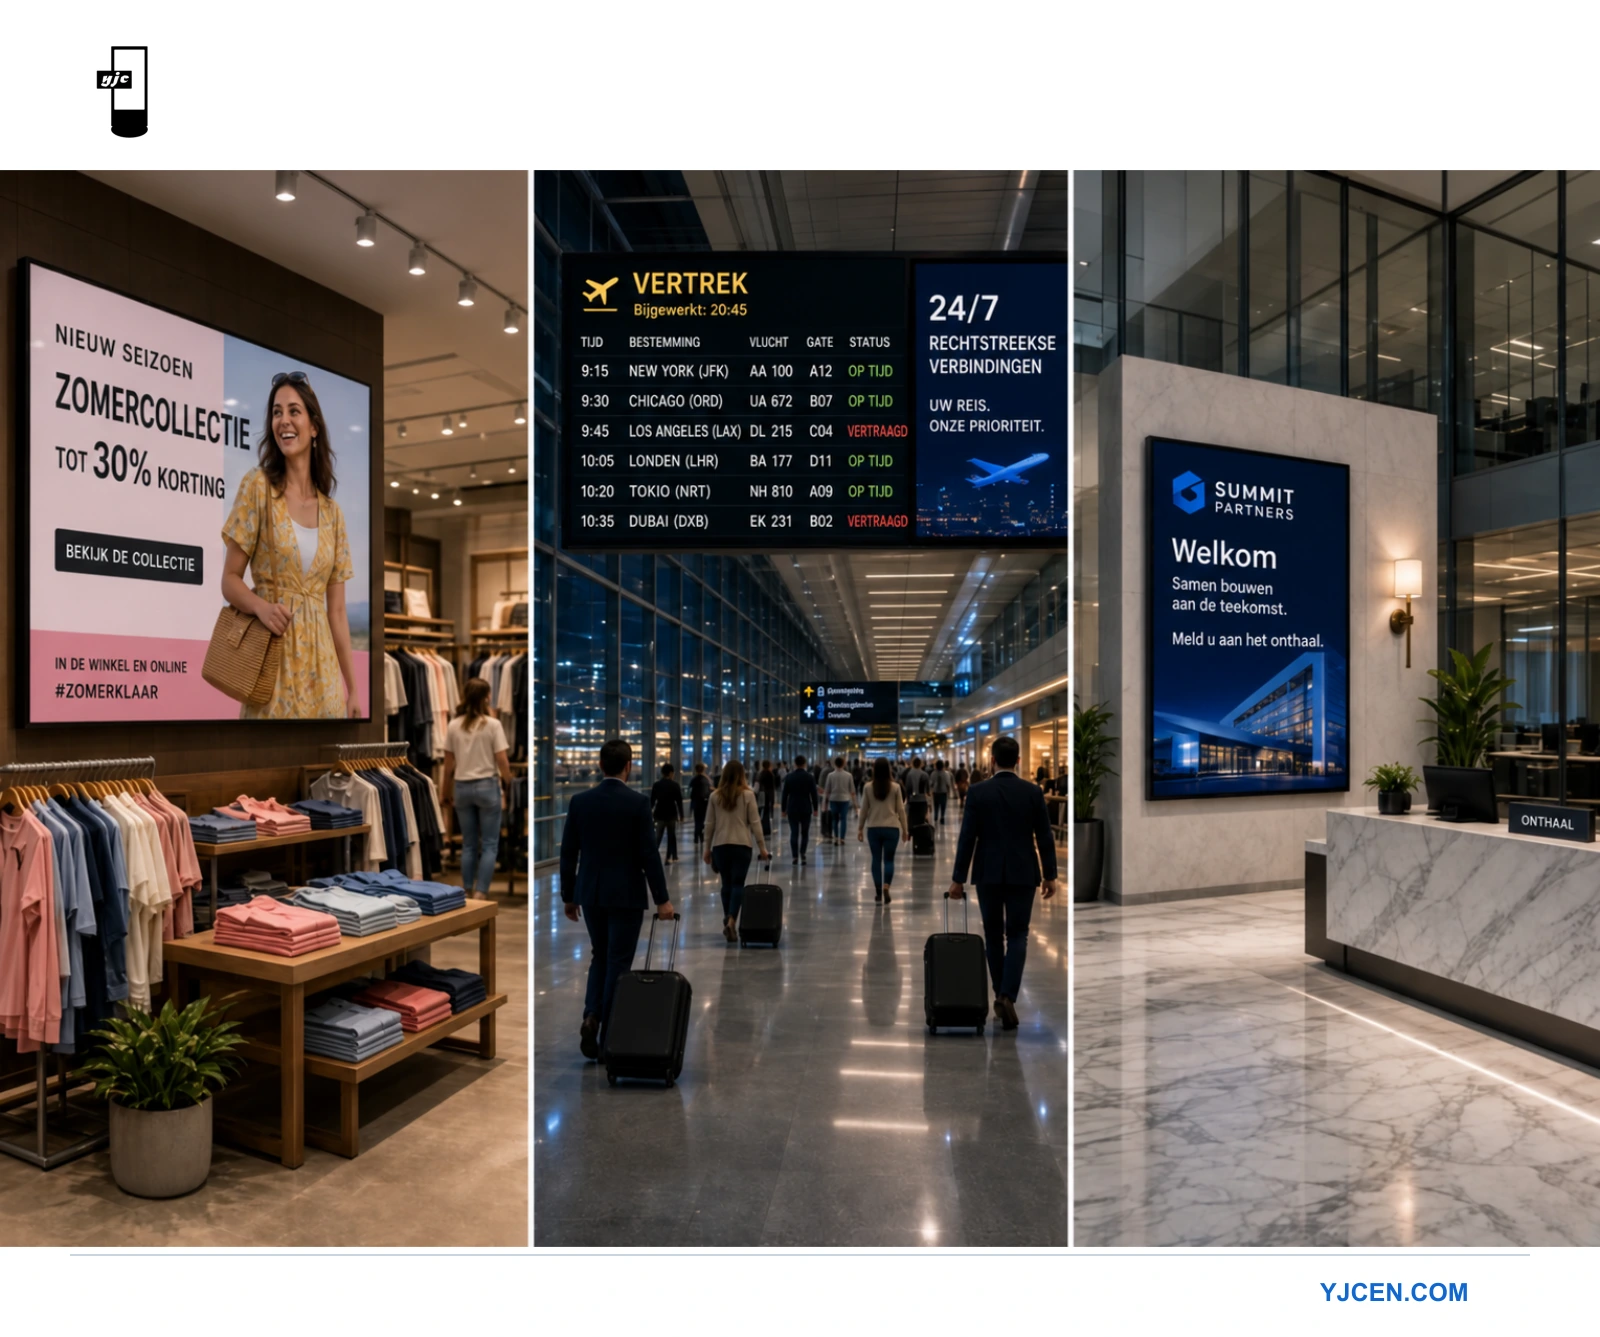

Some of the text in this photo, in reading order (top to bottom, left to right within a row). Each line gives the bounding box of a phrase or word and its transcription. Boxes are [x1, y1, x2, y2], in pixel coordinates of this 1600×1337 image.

[633, 272, 748, 294] VERTREK
[634, 303, 747, 319] Bijgewerkt: 20:45
[930, 294, 998, 323] 24/7
[581, 337, 890, 347] TIJD BESTEMMING VLUCHT GATE STATUS
[930, 336, 1056, 350] RECHTSTREEKSE
[56, 324, 192, 379] NIEUW SEIZOEN
[582, 365, 893, 379] 9:15 NEW YORK (JFK) AA 100 A12 OP TIJD
[930, 359, 1041, 373] VERBINDINGEN
[582, 394, 893, 409] 9:30 CHICAGO (ORD) UA 672 B07 OP TIJD
[930, 399, 990, 411] UW REIS.
[55, 371, 250, 451] ZOMERCOLLECTIE
[582, 424, 908, 439] 9:45 LOS ANGELES (LAX) DL 215 C04 VERTRAAGD
[930, 420, 1044, 432] ONZE PRIORITEIT.
[582, 454, 893, 469] 10:05 LONDEN (LHR) BA 177 D11 OP TIJD
[55, 441, 225, 499] TOT 30% KORTING
[581, 485, 893, 499] 10:20 TOKIO (NRT) NH 810 A09 OP TIJD
[1215, 481, 1294, 505] SUMMIT
[1215, 501, 1294, 521] PARTNERS
[582, 515, 908, 529] 10:35 DUBAI (DXB) EK 231 B02 VERTRAAGD
[67, 544, 194, 571] BEKIJK DE COLLECTIE
[1172, 538, 1276, 569] Welkom
[1173, 577, 1272, 595] Samen bouwen
[1172, 600, 1195, 610] aan
[1200, 598, 1216, 611] de
[1173, 632, 1323, 647] Meld u aan het onthaal.
[56, 658, 187, 673] IN DE WINKEL EN ONLINE
[56, 684, 158, 699] #ZOMERKLAAR
[1522, 815, 1574, 830] ONTHAAL
